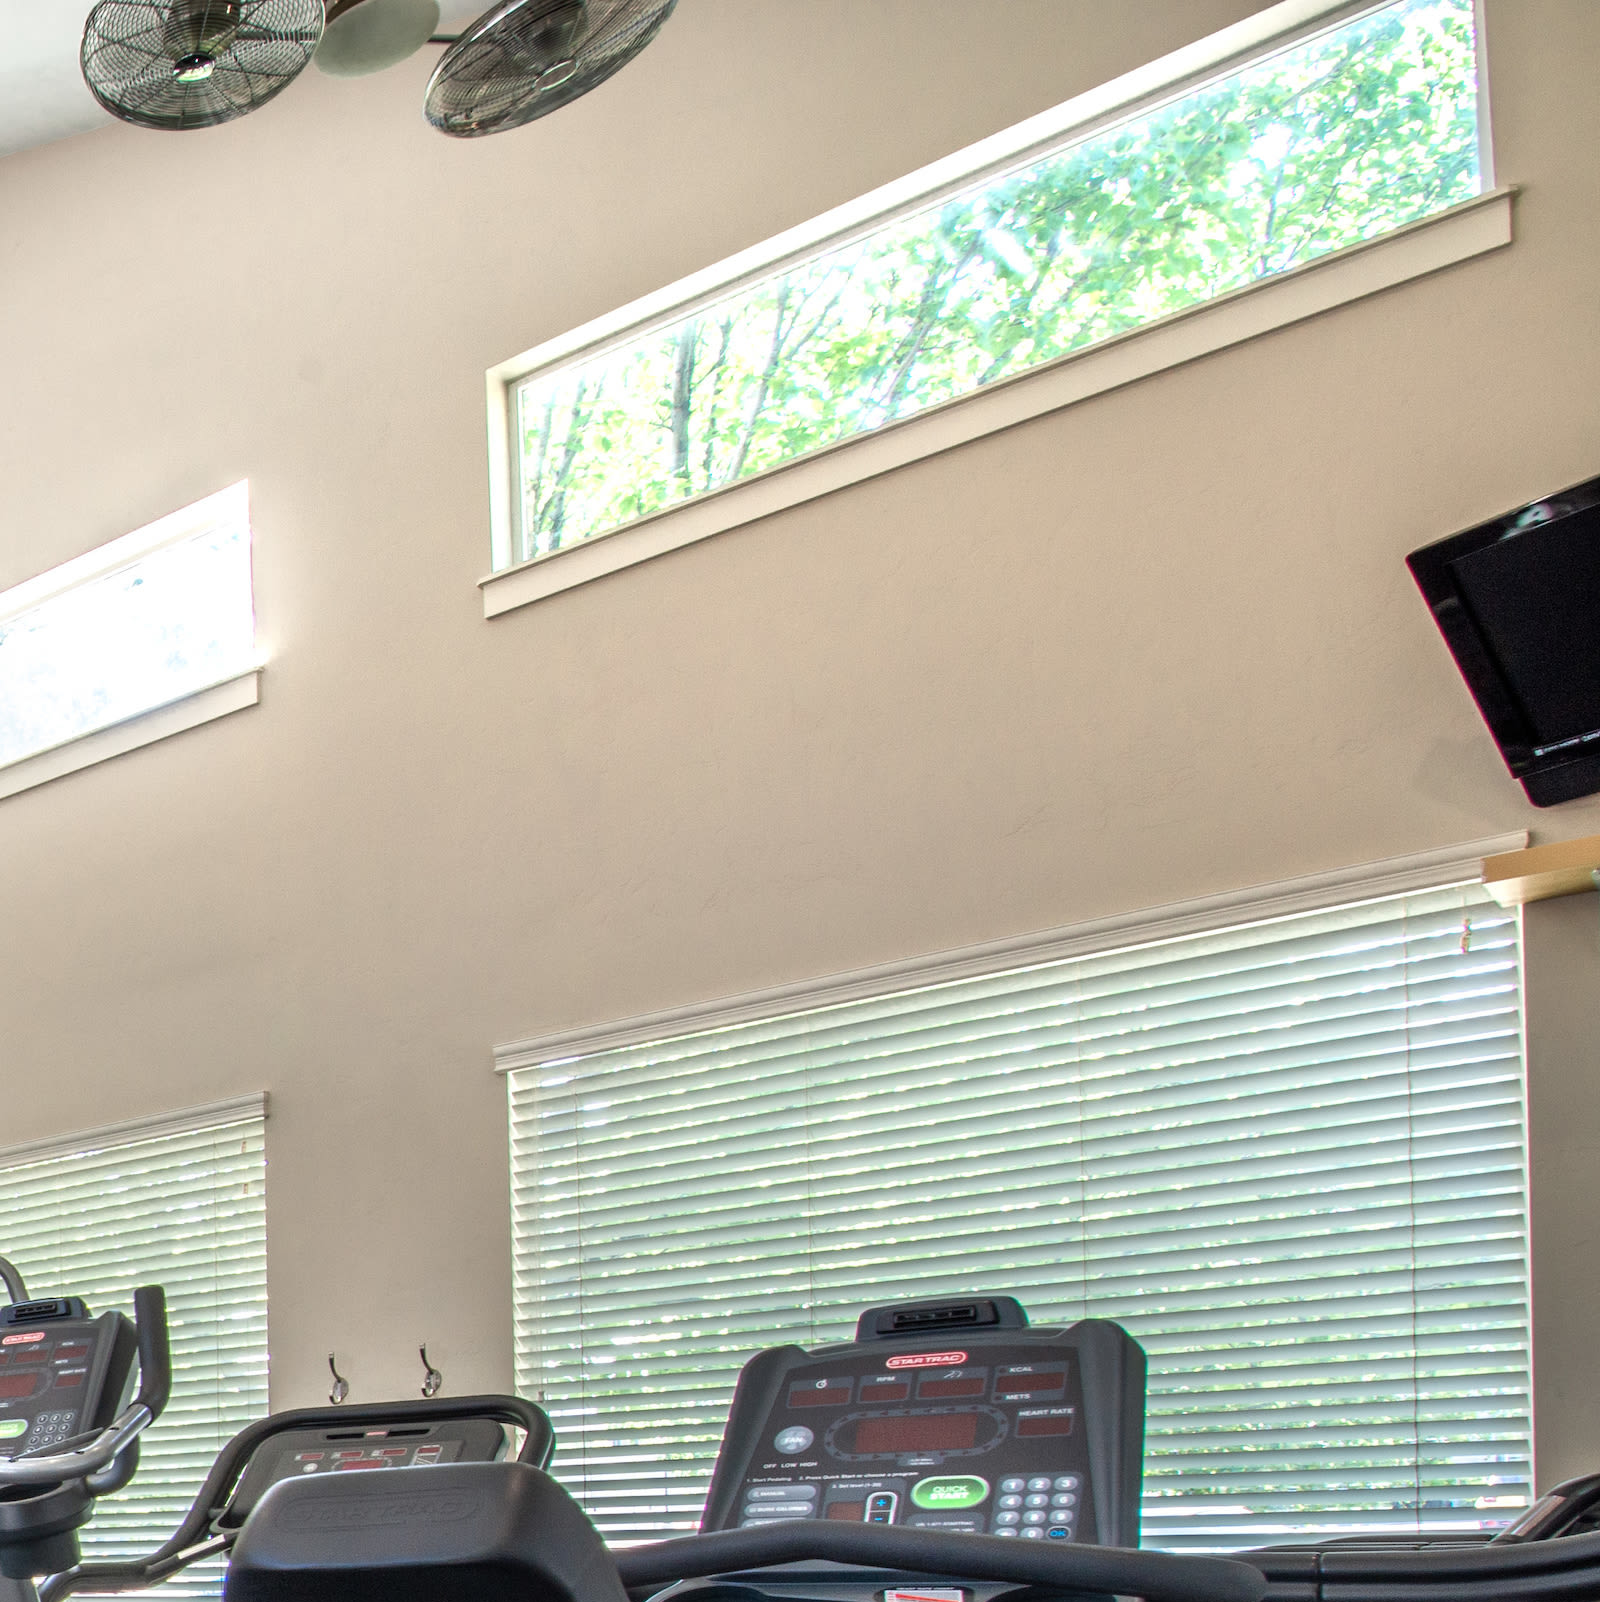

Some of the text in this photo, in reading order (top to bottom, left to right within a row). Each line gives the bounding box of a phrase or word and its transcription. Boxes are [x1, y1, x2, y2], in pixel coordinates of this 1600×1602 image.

[890, 1354, 961, 1365] STAR TRAC
[1019, 1407, 1074, 1416] HEART RATE
[784, 1436, 803, 1444] FAN
[932, 1485, 968, 1494] QUICK
[929, 1492, 969, 1501] START
